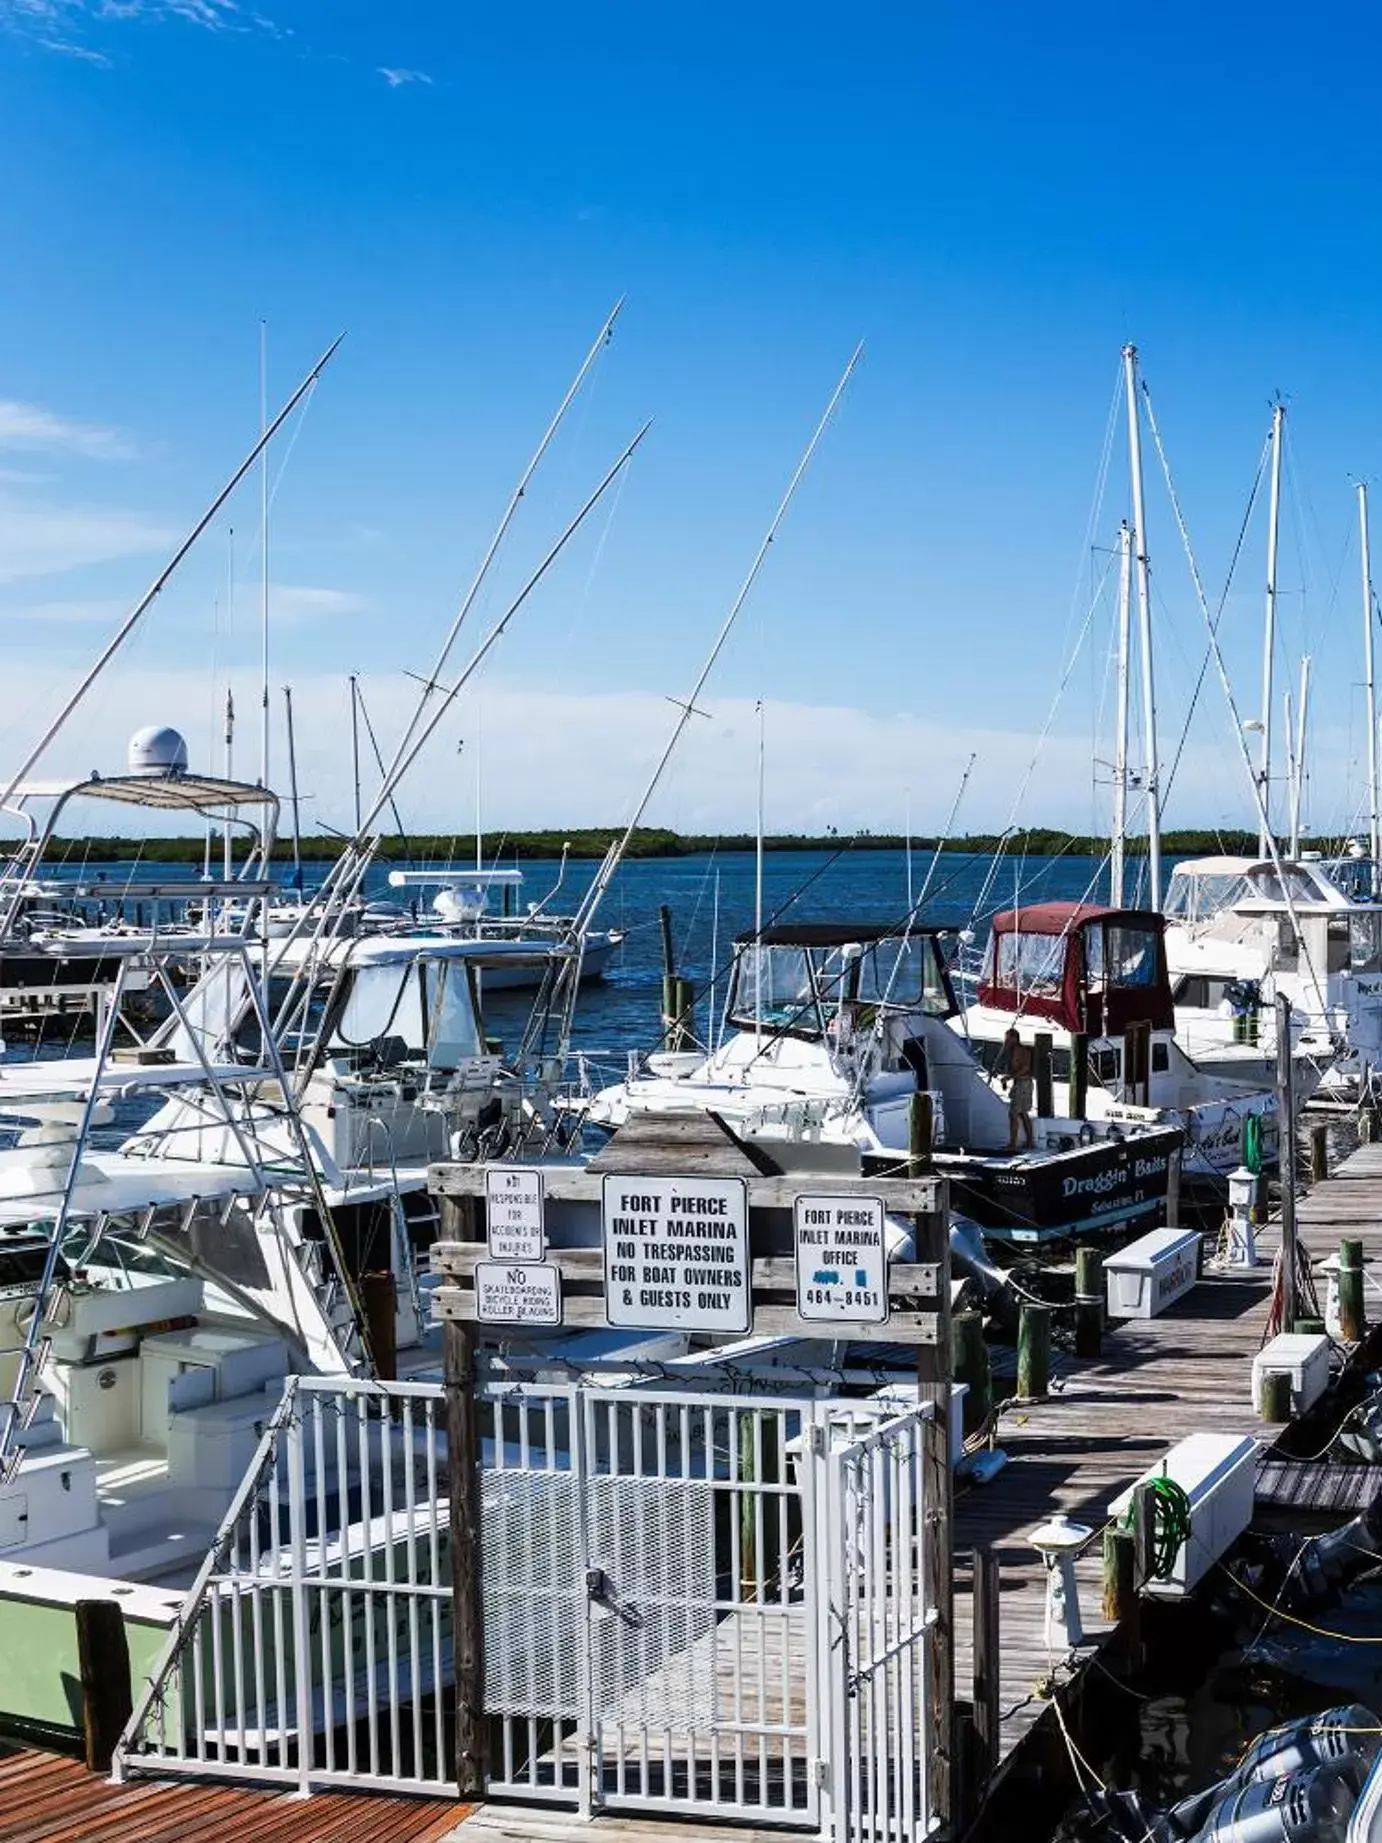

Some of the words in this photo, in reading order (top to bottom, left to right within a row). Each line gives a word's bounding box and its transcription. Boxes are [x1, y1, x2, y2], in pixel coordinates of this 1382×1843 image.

[1062, 1163, 1131, 1197] Draggin'
[621, 1195, 661, 1213] FORT
[671, 1197, 728, 1215] PIERCE
[805, 1210, 831, 1225] FORT
[837, 1210, 874, 1226] PIERCE
[613, 1218, 658, 1236] INLET
[667, 1220, 737, 1239] MARINA
[800, 1230, 829, 1245] INLET
[835, 1231, 880, 1246] MARINA
[617, 1242, 635, 1260] NO
[644, 1243, 735, 1263] TRESPASSING
[822, 1251, 858, 1265] OFFICE
[507, 1271, 526, 1285] NO
[611, 1265, 635, 1282] FOR
[643, 1266, 676, 1284] BOAT
[684, 1268, 742, 1287] OWNERS
[483, 1284, 552, 1296] SKATEBOARDING
[623, 1288, 633, 1306] &
[640, 1290, 691, 1308] GUESTS
[698, 1292, 731, 1309] ONLY
